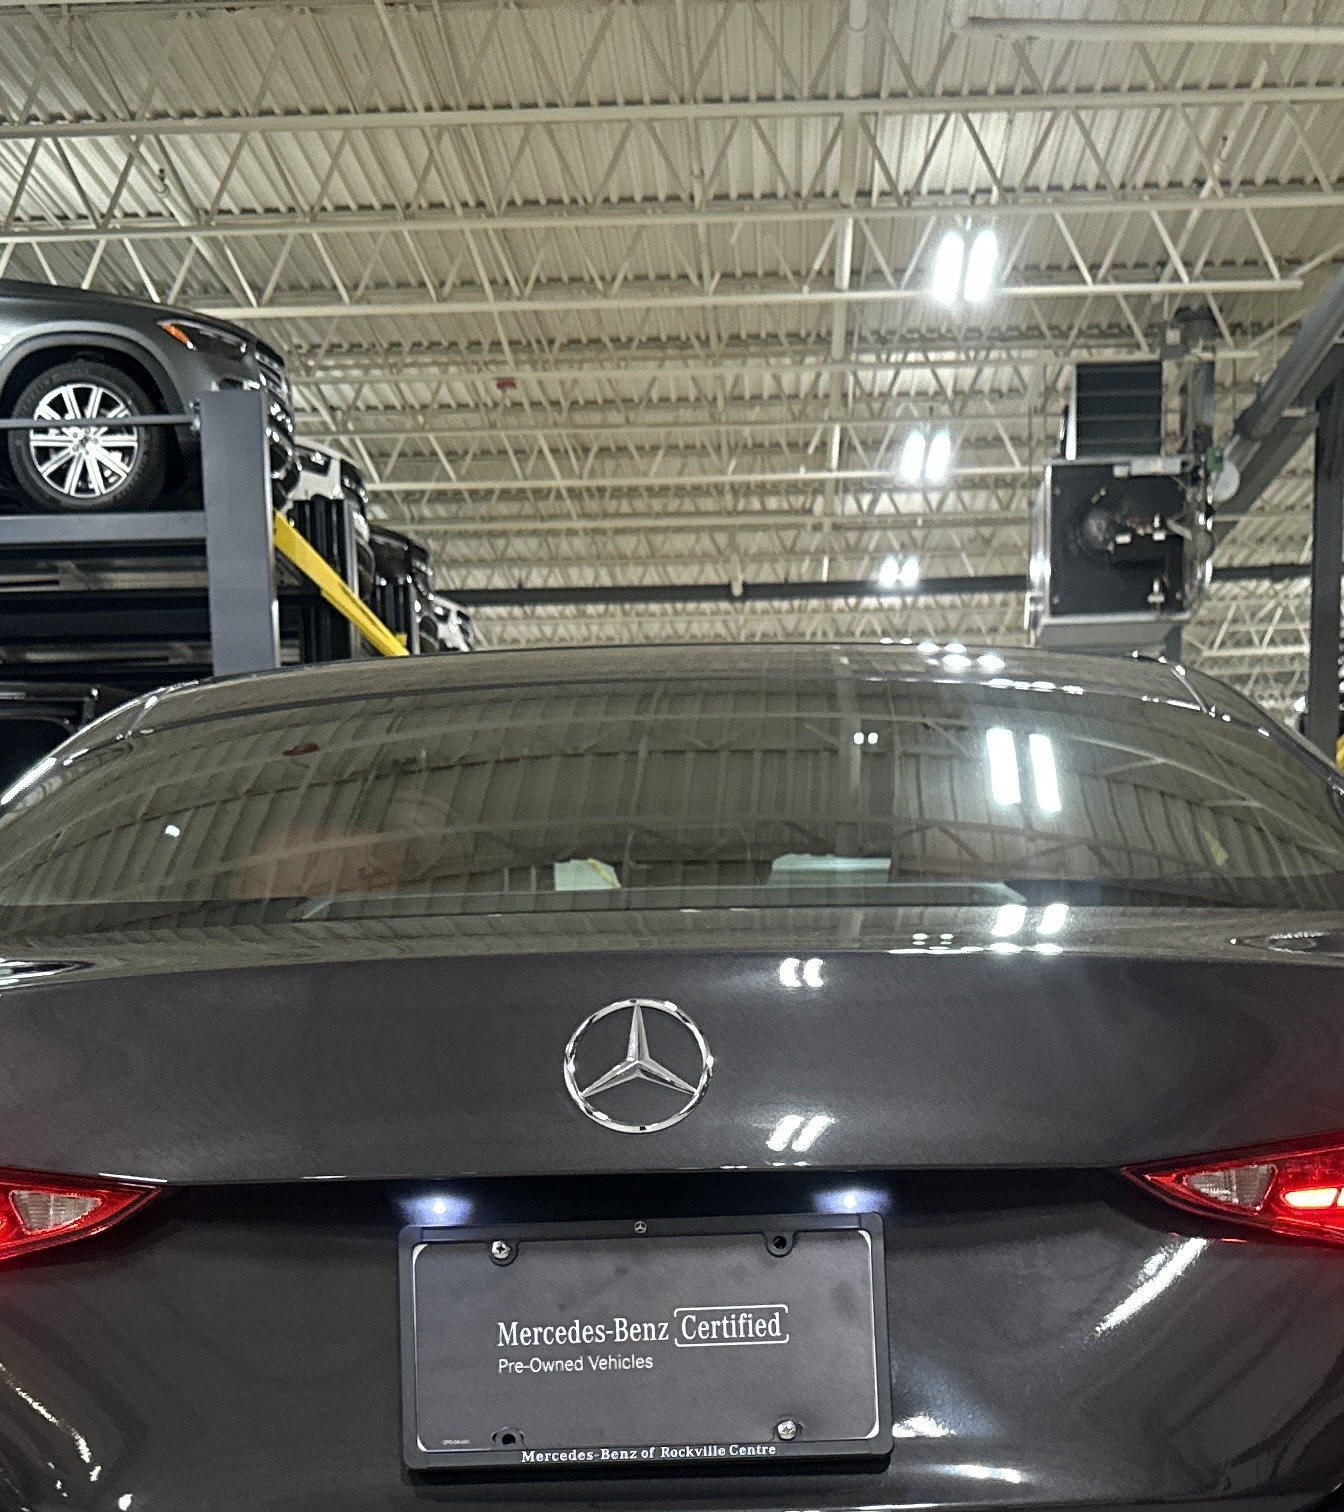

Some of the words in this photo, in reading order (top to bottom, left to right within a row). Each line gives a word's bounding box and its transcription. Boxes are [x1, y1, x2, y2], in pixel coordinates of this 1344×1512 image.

[497, 1317, 669, 1347] Mercedes-Benz
[681, 1312, 782, 1340] Certified
[498, 1356, 584, 1373] Pre-Owned
[587, 1354, 654, 1370] Vehicles
[521, 1448, 637, 1463] Mercedes-Benz
[641, 1447, 655, 1459] of
[661, 1446, 726, 1458] Rockville
[729, 1444, 777, 1456] Centre
